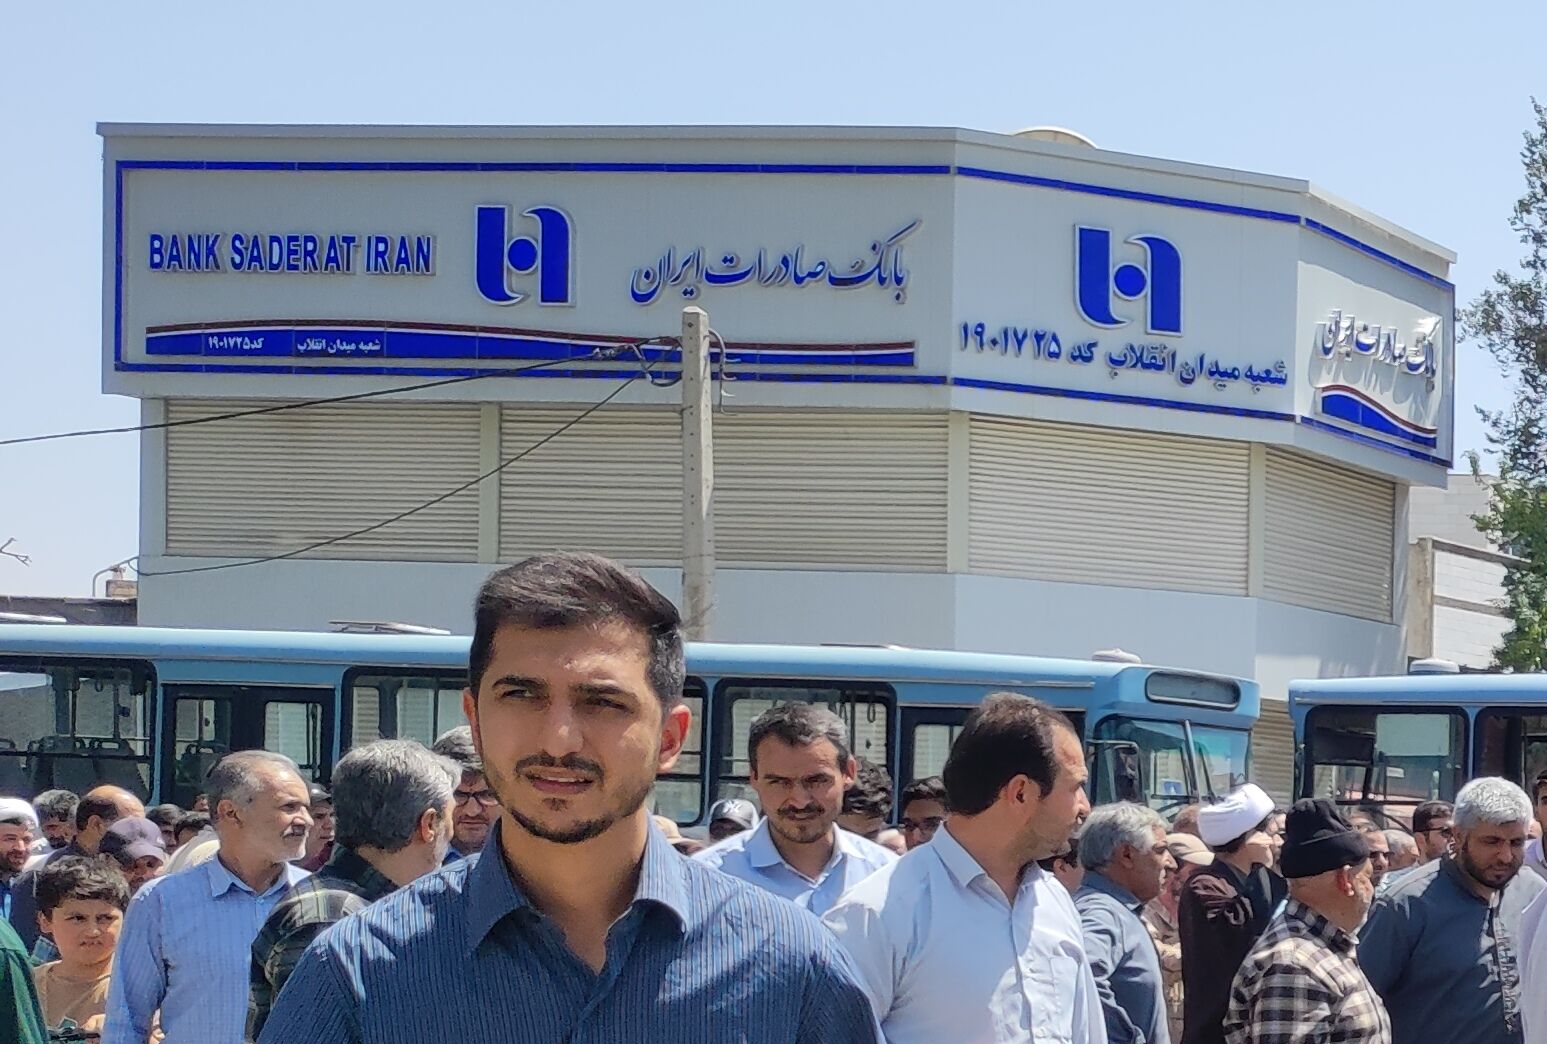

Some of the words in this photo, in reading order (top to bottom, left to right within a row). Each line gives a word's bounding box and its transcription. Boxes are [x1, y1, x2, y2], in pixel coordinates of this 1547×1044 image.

[149, 233, 222, 273] BANK
[229, 233, 357, 274] SADERAT
[364, 234, 433, 275] IRAN
[703, 243, 827, 286] صادرات
[629, 247, 704, 305] ایران
[1068, 340, 1099, 364] کد
[1107, 342, 1178, 380] انقلاب
[1178, 352, 1241, 391] میدان
[1243, 360, 1288, 394] شعبه
